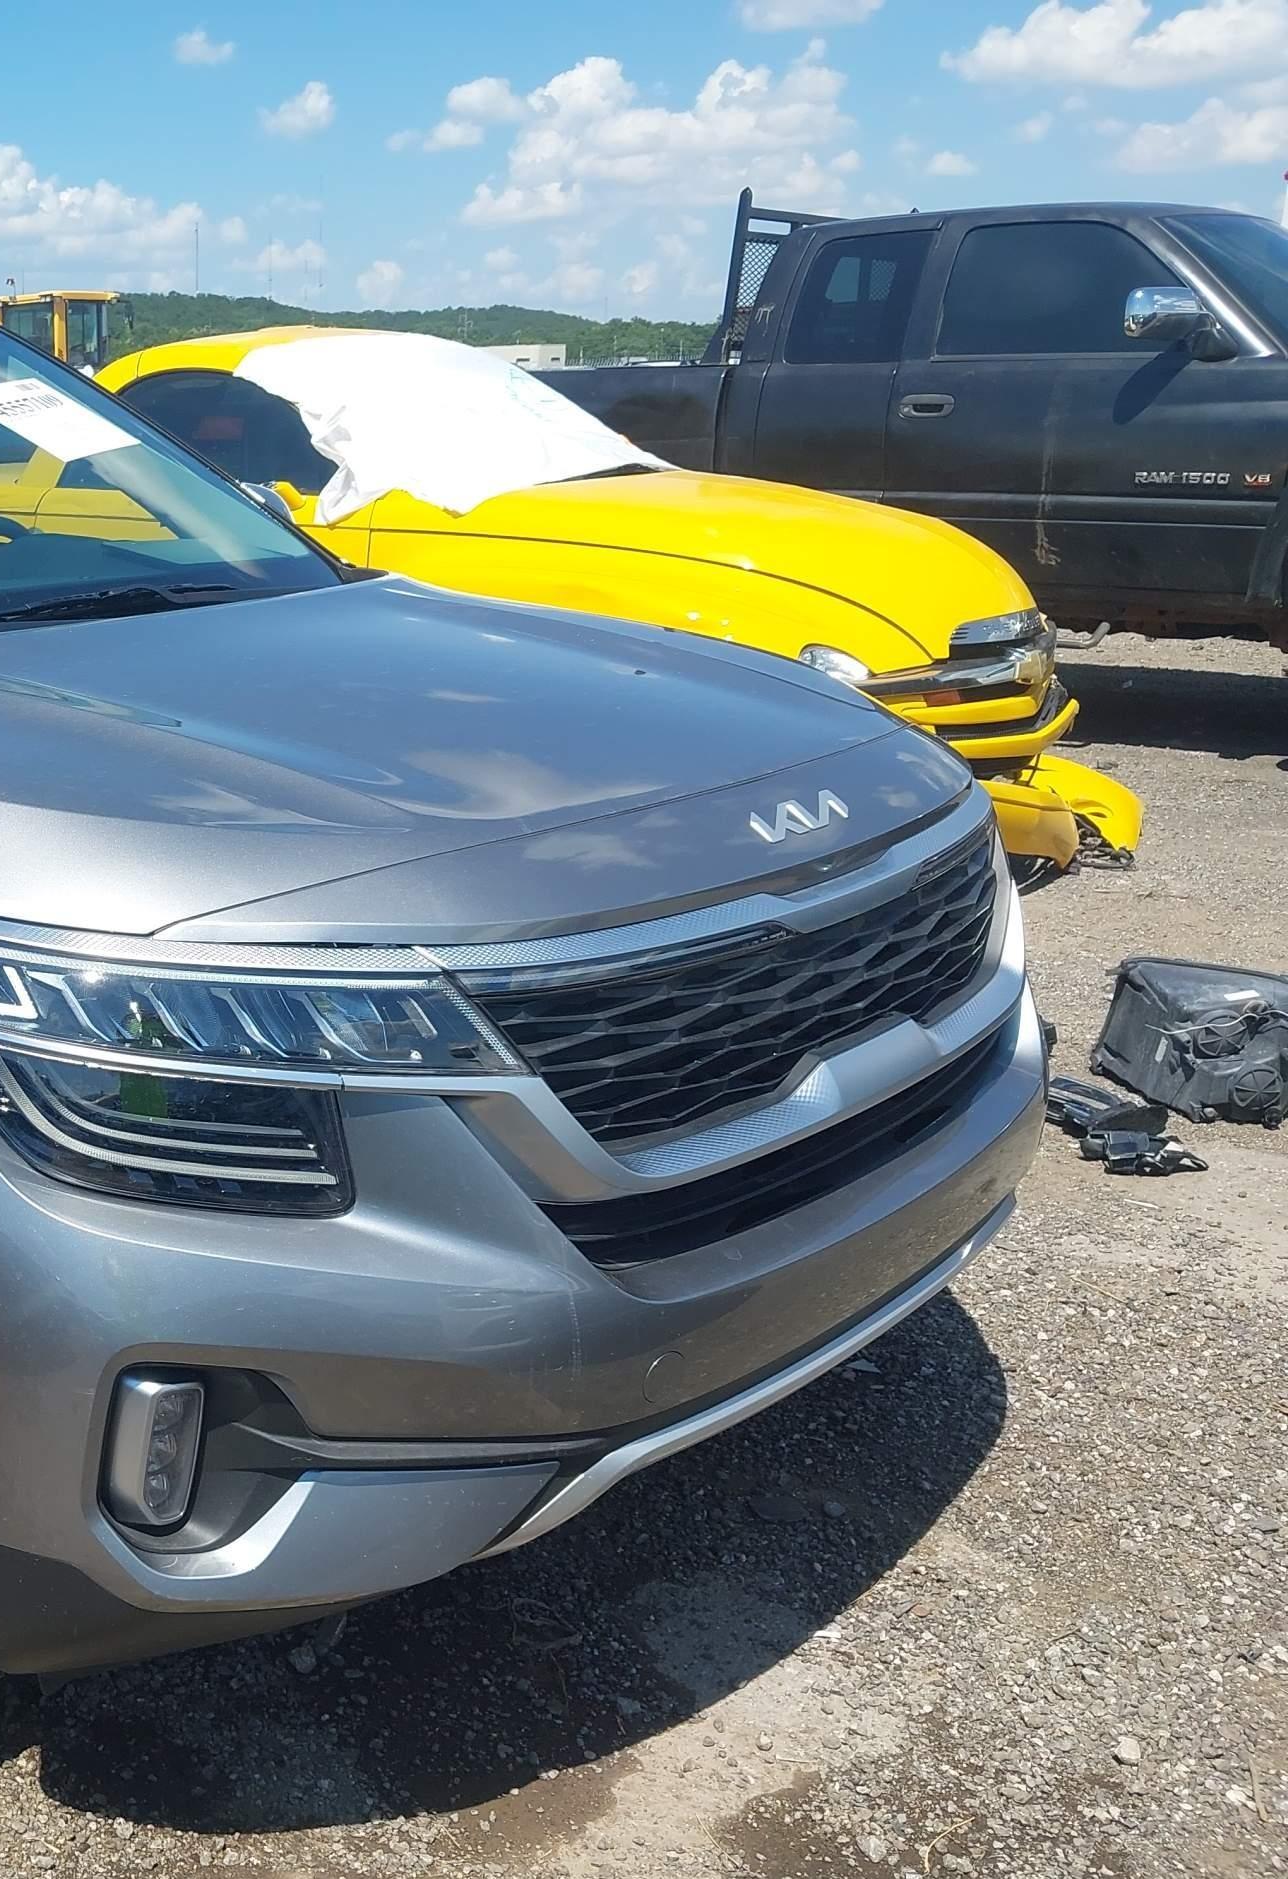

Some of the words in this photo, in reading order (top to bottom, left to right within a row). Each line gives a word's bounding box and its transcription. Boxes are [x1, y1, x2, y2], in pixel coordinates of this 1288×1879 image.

[1134, 471, 1175, 484] RAM
[1181, 472, 1231, 485] 1500
[1244, 473, 1272, 483] V8
[749, 789, 849, 843] KIA
